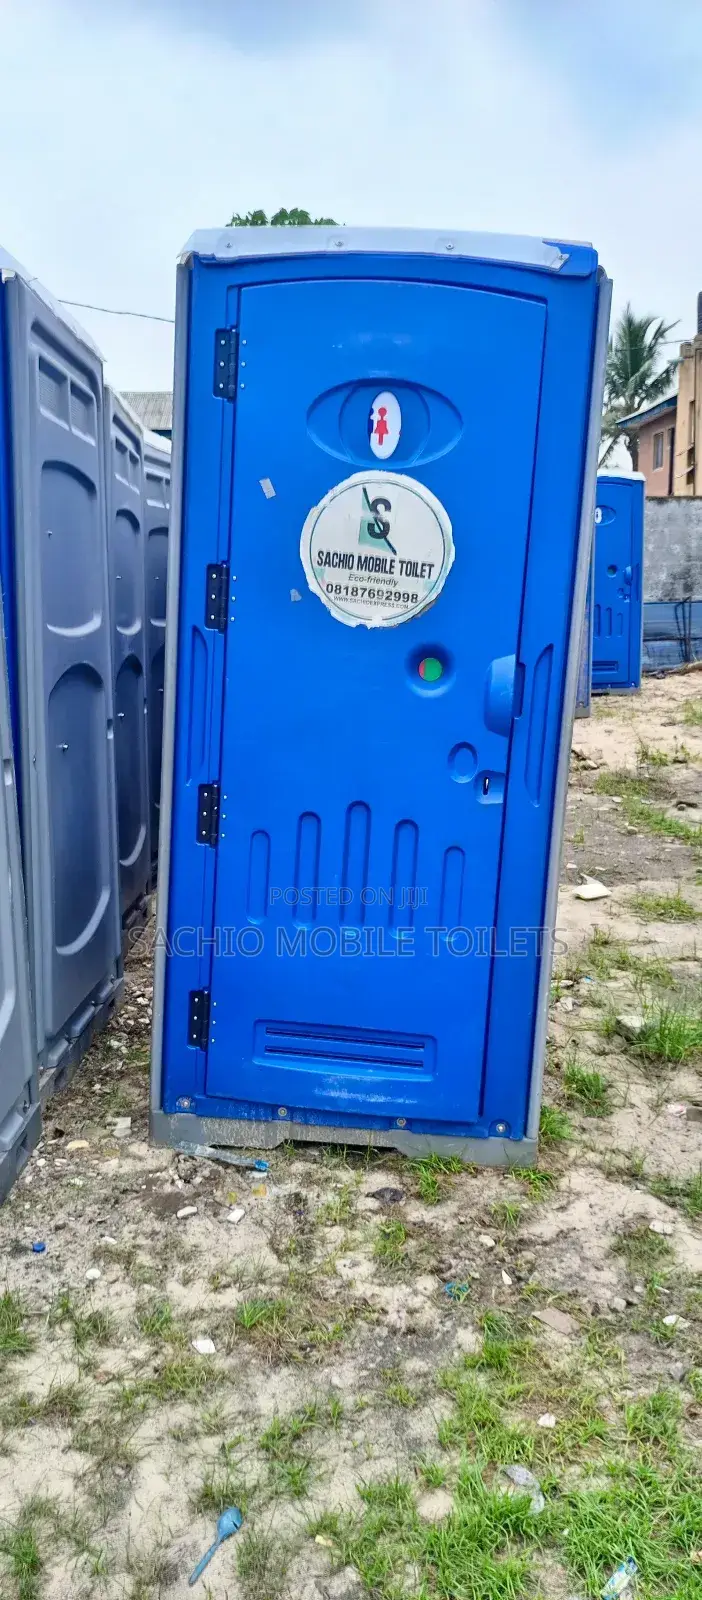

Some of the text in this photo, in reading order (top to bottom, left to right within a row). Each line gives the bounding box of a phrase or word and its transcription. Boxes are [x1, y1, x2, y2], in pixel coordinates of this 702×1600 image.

[317, 550, 435, 579] SACHIO MOBILE TOILET
[348, 574, 399, 587] Eco-friendly
[325, 583, 419, 603] 08187692998
